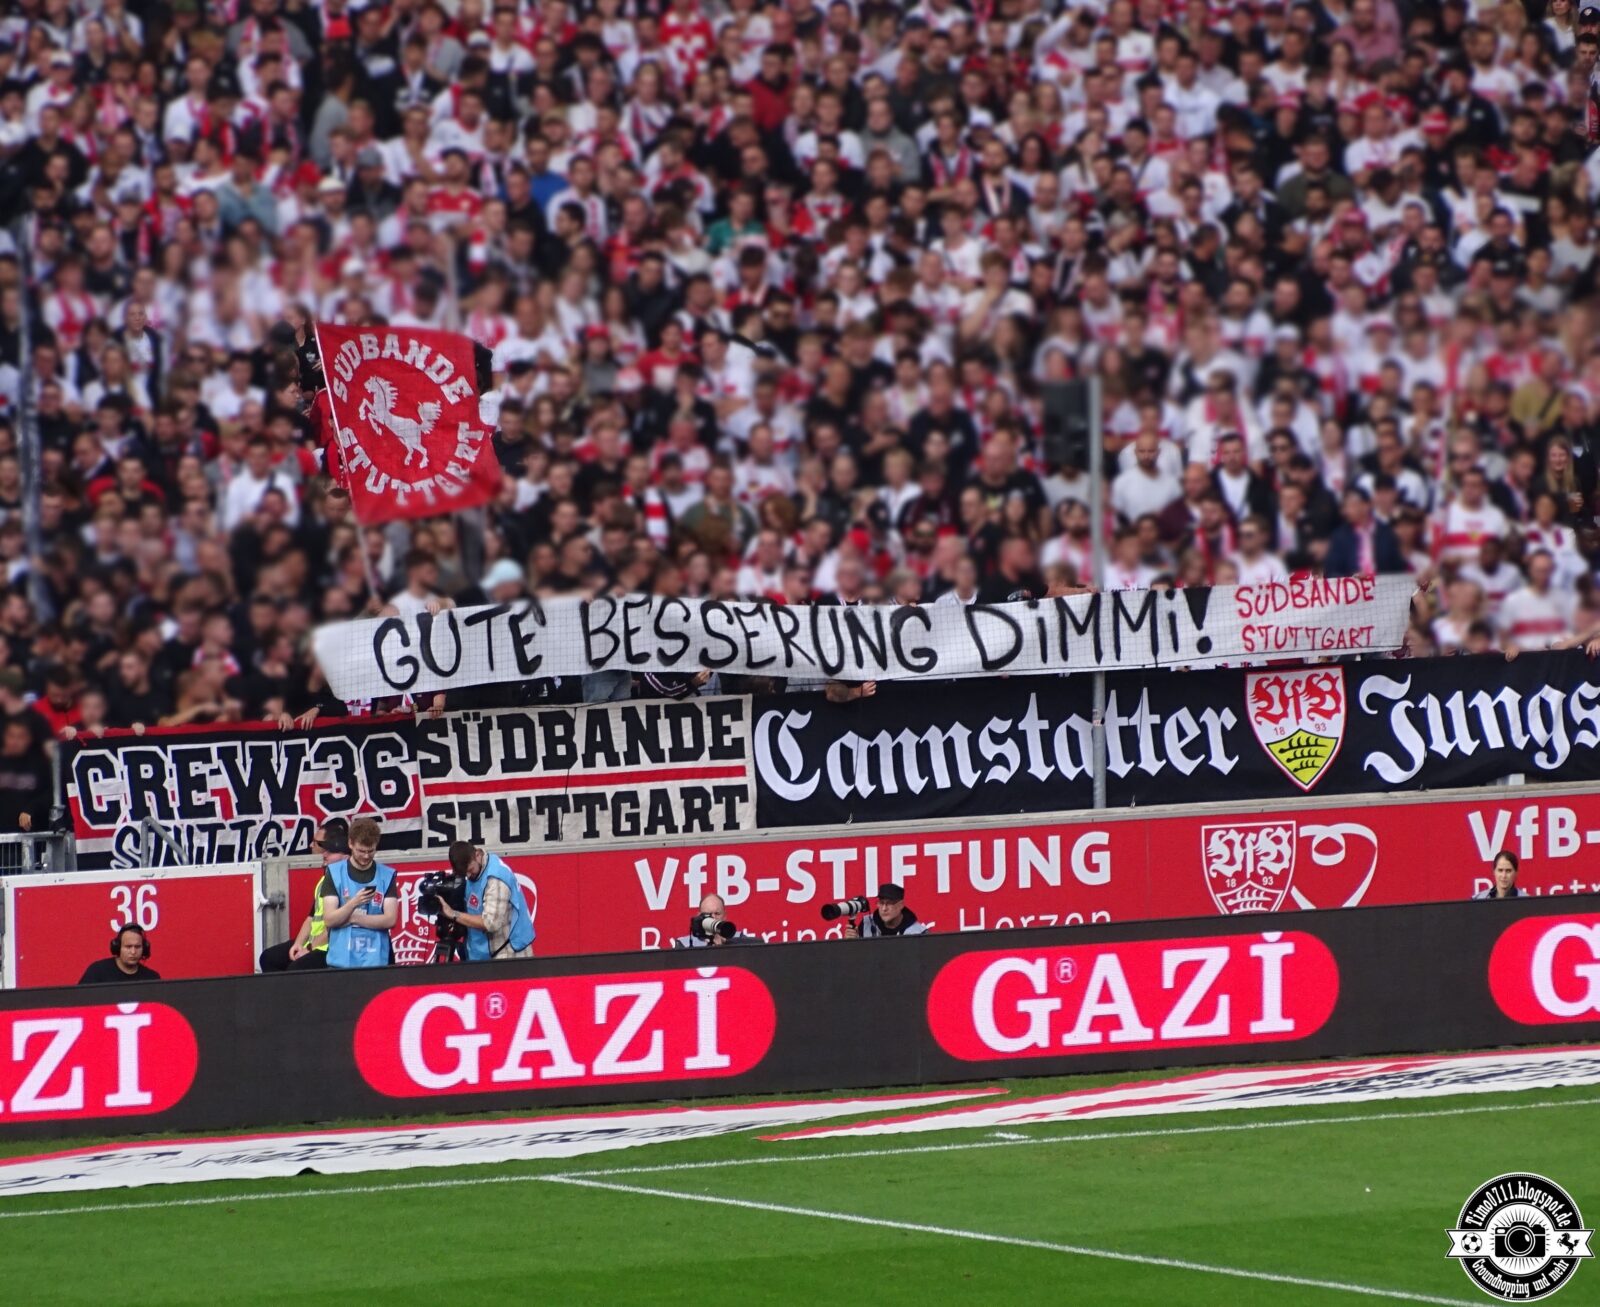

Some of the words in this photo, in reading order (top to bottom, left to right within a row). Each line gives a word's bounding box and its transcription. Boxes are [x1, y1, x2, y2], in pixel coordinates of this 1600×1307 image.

[333, 333, 473, 403] SÜDBANDE
[373, 599, 545, 690] GUTE
[580, 595, 938, 676] BESSERUNG
[1242, 625, 1375, 653] STUTTGART
[1250, 672, 1342, 726] VfB
[416, 699, 746, 779] SÜDBANDE
[754, 687, 1239, 801] Cannstatter
[1274, 727, 1286, 736] 18
[1315, 722, 1327, 732] 93
[1359, 673, 1600, 783] Jungs
[110, 815, 384, 870] STUTTGA
[427, 784, 750, 849] STUTTGART
[634, 831, 1111, 911] VfB-STIFTUNG
[1207, 827, 1292, 879] VfB
[110, 884, 159, 932] 36
[1226, 879, 1237, 888] 18
[1263, 876, 1274, 885] 93
[418, 926, 429, 936] 93
